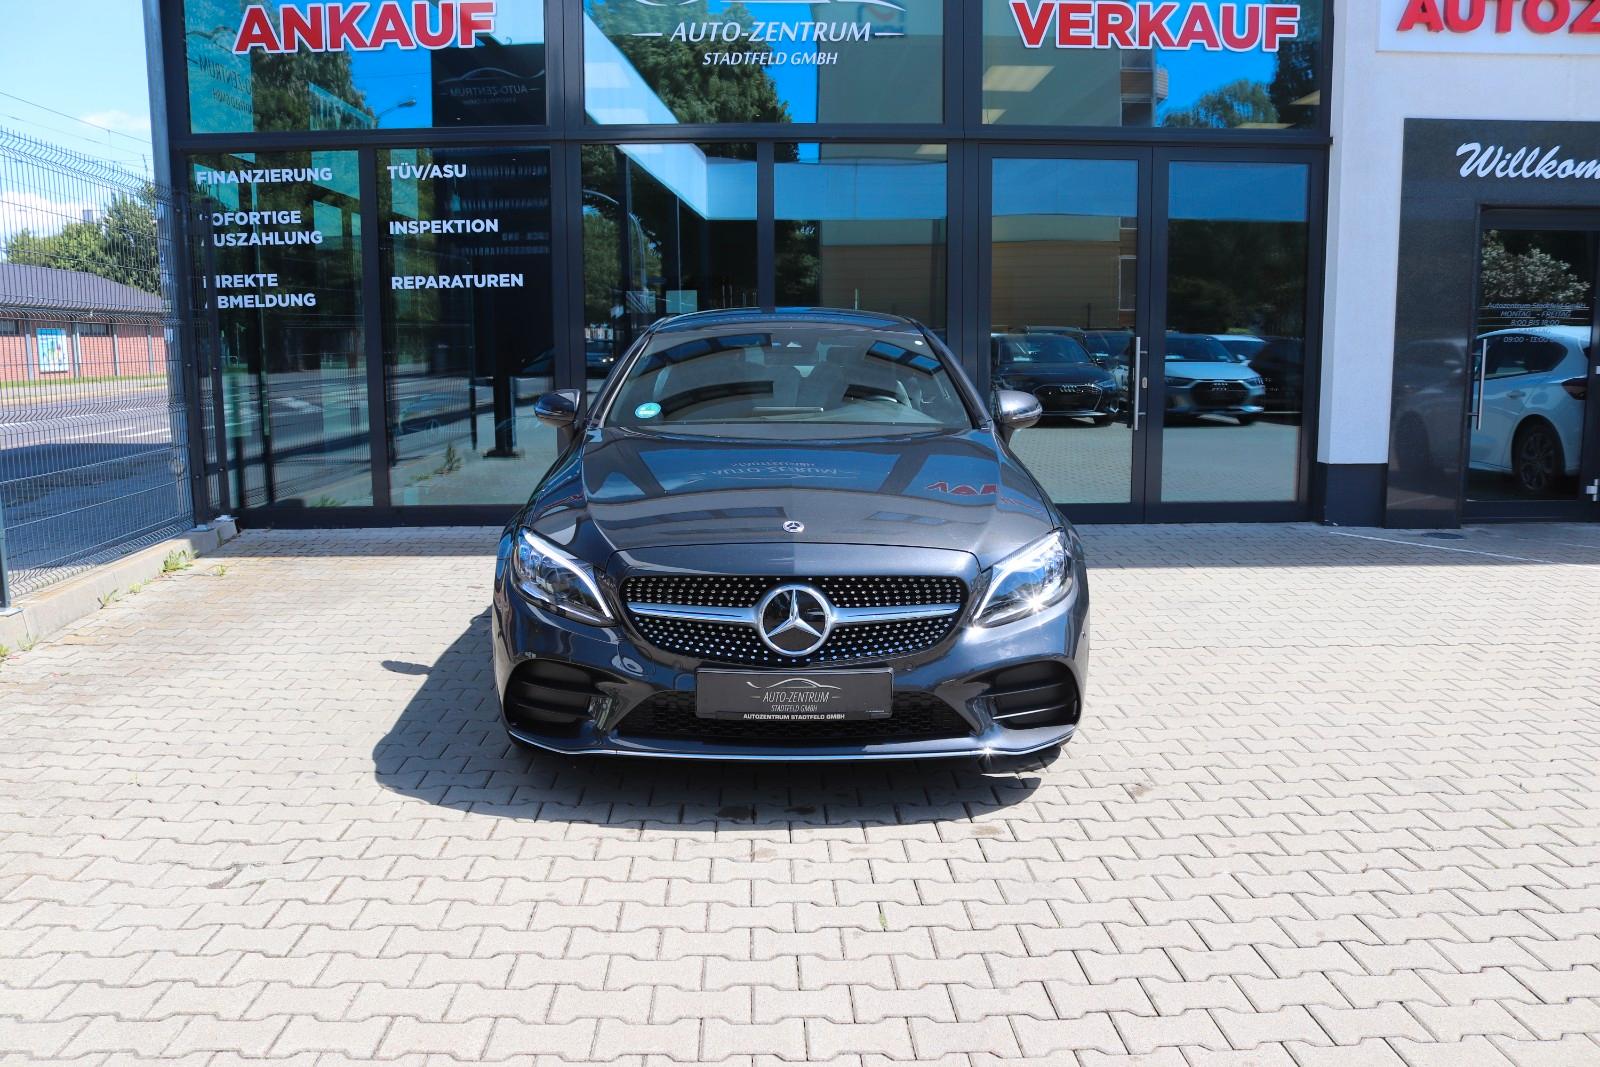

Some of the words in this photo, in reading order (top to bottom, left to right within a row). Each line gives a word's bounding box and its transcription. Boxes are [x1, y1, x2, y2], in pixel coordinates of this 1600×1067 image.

[232, 1, 497, 54] ANKAUF
[670, 22, 871, 42] AUTO-ZENTRUM
[1010, 1, 1300, 52] VERKAUF
[702, 52, 788, 66] STADTFELD
[790, 52, 838, 65] GMBH
[1456, 142, 1600, 179] Willkom
[196, 167, 333, 186] FINANZIERUNG
[387, 162, 467, 180] TÜV/ASU
[200, 210, 302, 226] OFORTIGE
[389, 219, 499, 236] INSPEKTION
[201, 230, 323, 247] USZAHLUNG
[203, 273, 279, 289] IREKTE
[391, 273, 524, 290] REPARATUREN
[204, 293, 316, 309] BMELDUNG
[762, 691, 830, 703] AUTO-ZENTRUM
[770, 704, 800, 712] STADTFELD
[800, 704, 818, 712] GMBH
